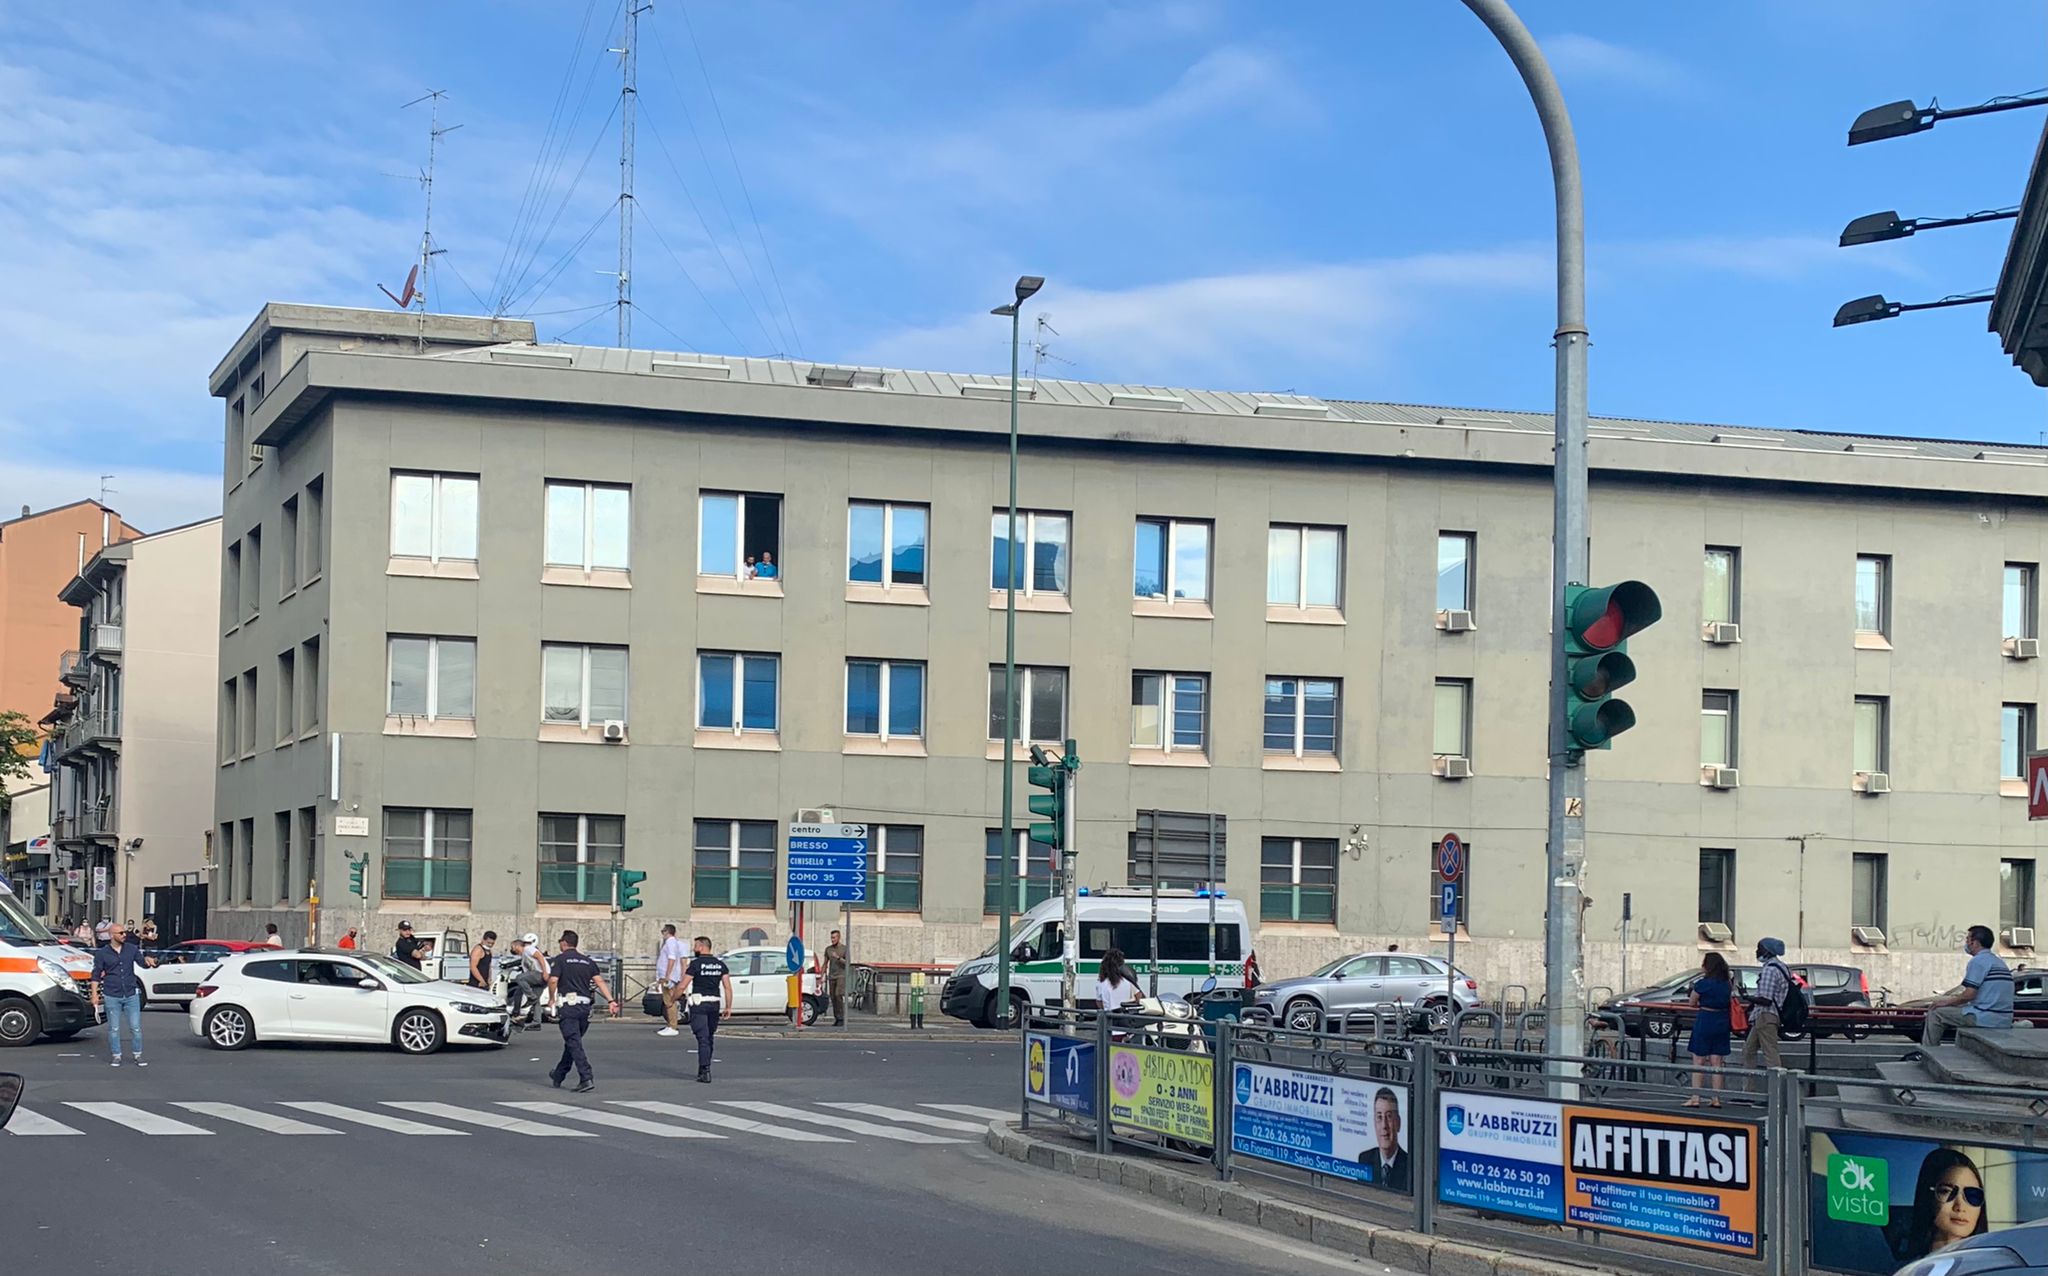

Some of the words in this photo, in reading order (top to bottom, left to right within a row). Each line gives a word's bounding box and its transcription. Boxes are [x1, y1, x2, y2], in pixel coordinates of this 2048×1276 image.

[792, 825, 821, 833] centro
[790, 841, 828, 850] BRESSO
[790, 857, 824, 866] CINISELLO
[1566, 864, 1576, 877] 3
[789, 873, 818, 881] COMO
[823, 874, 835, 882] 35
[788, 888, 821, 897] LECCO
[826, 889, 839, 897] 45
[1444, 886, 1454, 913] P
[1144, 964, 1180, 973] Lcale
[1144, 1054, 1176, 1081] ASILO
[1179, 1059, 1213, 1087] NIDO
[1156, 1084, 1162, 1094] 0
[1169, 1086, 1175, 1097] 3
[1177, 1087, 1198, 1101] ANNI
[1254, 1075, 1333, 1106] L'ABBRUZZI
[1148, 1096, 1175, 1109] SERVIZIO
[1176, 1101, 1208, 1116] WEB-CAM
[1254, 1096, 1282, 1109] GRUPPO
[1284, 1103, 1333, 1120] IMMOBILIARE
[1252, 1125, 1311, 1147] 02.26.26.5020
[1468, 1113, 1557, 1137] L'ABBRUZZI
[1468, 1130, 1499, 1140] GRUPPO
[1503, 1135, 1557, 1148] IMMOBILIARE
[1237, 1138, 1249, 1152] Via
[1250, 1141, 1274, 1158] Fiorani
[1276, 1147, 1288, 1158] 119
[1294, 1151, 1314, 1166] Sesto
[1316, 1156, 1330, 1170] San
[1332, 1160, 1368, 1179] Giovanni
[1573, 1123, 1747, 1183] AFFITTASI
[1452, 1160, 1468, 1173] Tel.
[1472, 1163, 1484, 1175] 02
[1488, 1165, 1501, 1178] 26
[1503, 1168, 1517, 1180] 26
[1520, 1171, 1534, 1183] 50
[1537, 1173, 1551, 1186] 20
[1457, 1178, 1544, 1199] www.labbruzzi.it
[1579, 1182, 1599, 1193] Devi
[1601, 1185, 1637, 1198] affittare
[1639, 1190, 1645, 1199] il
[1648, 1192, 1662, 1202] tuo
[1665, 1193, 1715, 1208] immobile?
[1457, 1191, 1477, 1200] Fiorani
[1478, 1194, 1490, 1202] 119
[1497, 1198, 1513, 1207] Sesto
[1514, 1200, 1526, 1209] San
[1528, 1202, 1558, 1214] Giovanni
[1594, 1196, 1609, 1207] Noi
[1612, 1201, 1627, 1210] con
[1630, 1202, 1639, 1212] la
[1641, 1205, 1670, 1218] nostra
[1673, 1212, 1727, 1229] esperienza
[1832, 1192, 1883, 1216] vista
[1571, 1208, 1577, 1218] ti
[1579, 1210, 1622, 1225] seguiamo
[1624, 1217, 1650, 1231] passo
[1653, 1221, 1680, 1236] passo
[1714, 1231, 1735, 1242] vuoi
[1738, 1234, 1752, 1245] tu.
